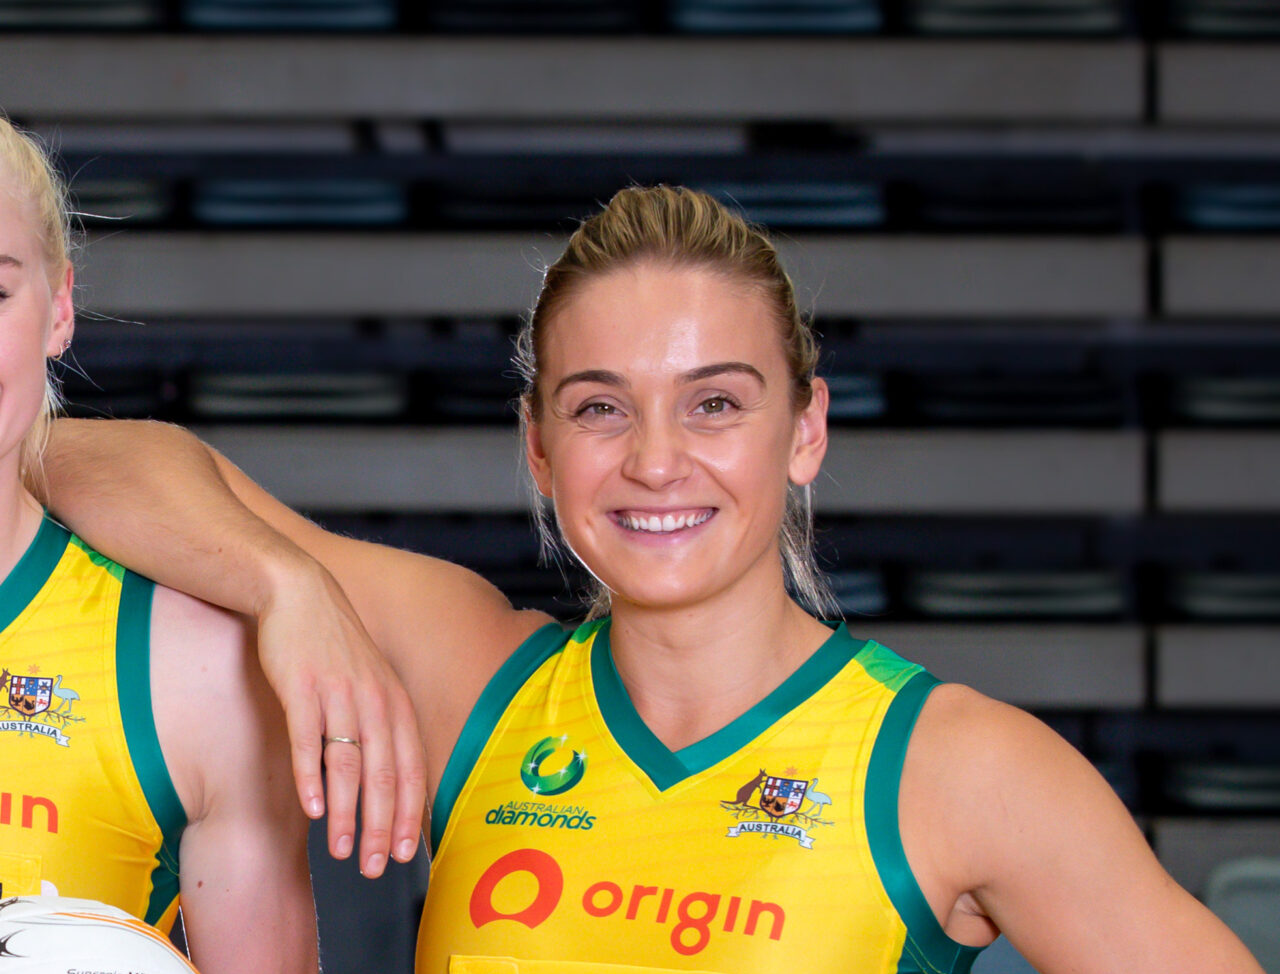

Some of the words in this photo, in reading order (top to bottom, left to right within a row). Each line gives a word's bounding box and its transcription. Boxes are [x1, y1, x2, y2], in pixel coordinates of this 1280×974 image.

[485, 805, 597, 831] diamonds
[506, 800, 585, 815] AUSTRALIAN
[740, 823, 803, 839] AUSTRALIA
[582, 881, 786, 956] origin
